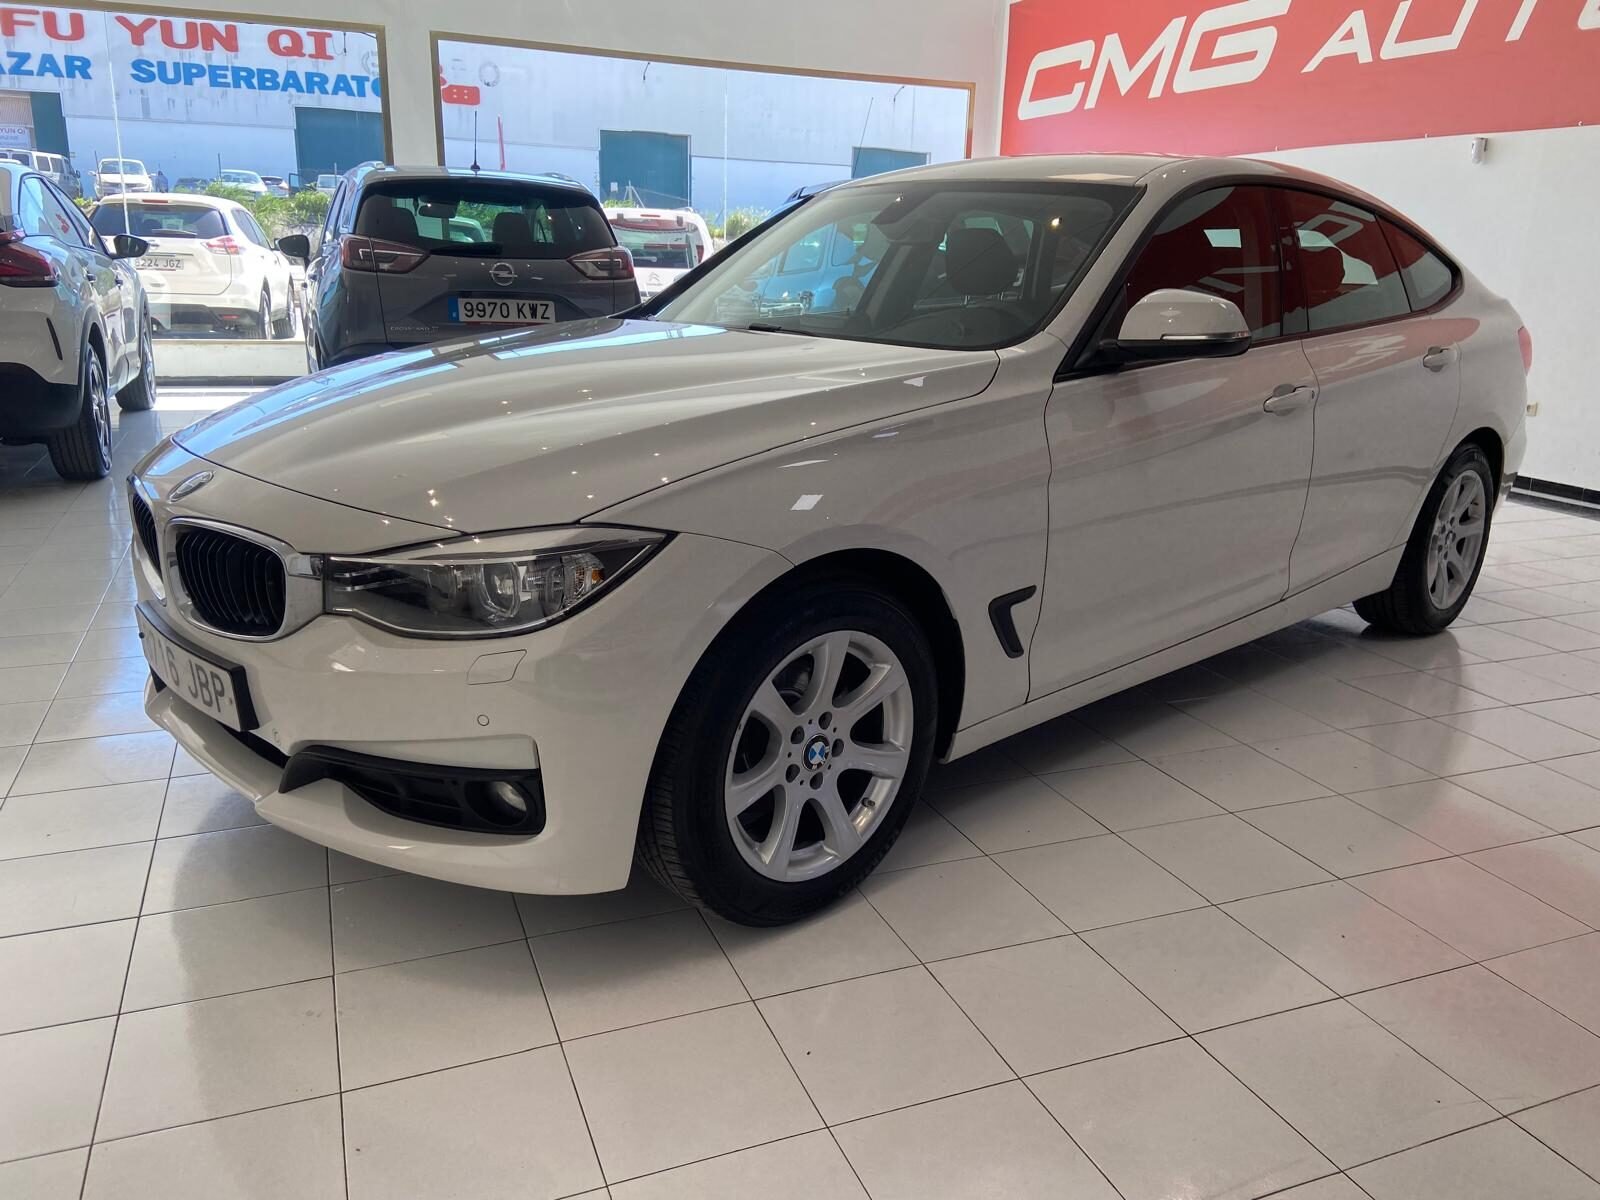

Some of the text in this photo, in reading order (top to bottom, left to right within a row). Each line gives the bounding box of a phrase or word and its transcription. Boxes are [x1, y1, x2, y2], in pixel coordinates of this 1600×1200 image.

[0, 7, 335, 61] FU YUN QI
[1018, 0, 1292, 120] CMG
[463, 302, 551, 320] 9970 KWZ
[188, 658, 225, 713] JBP
